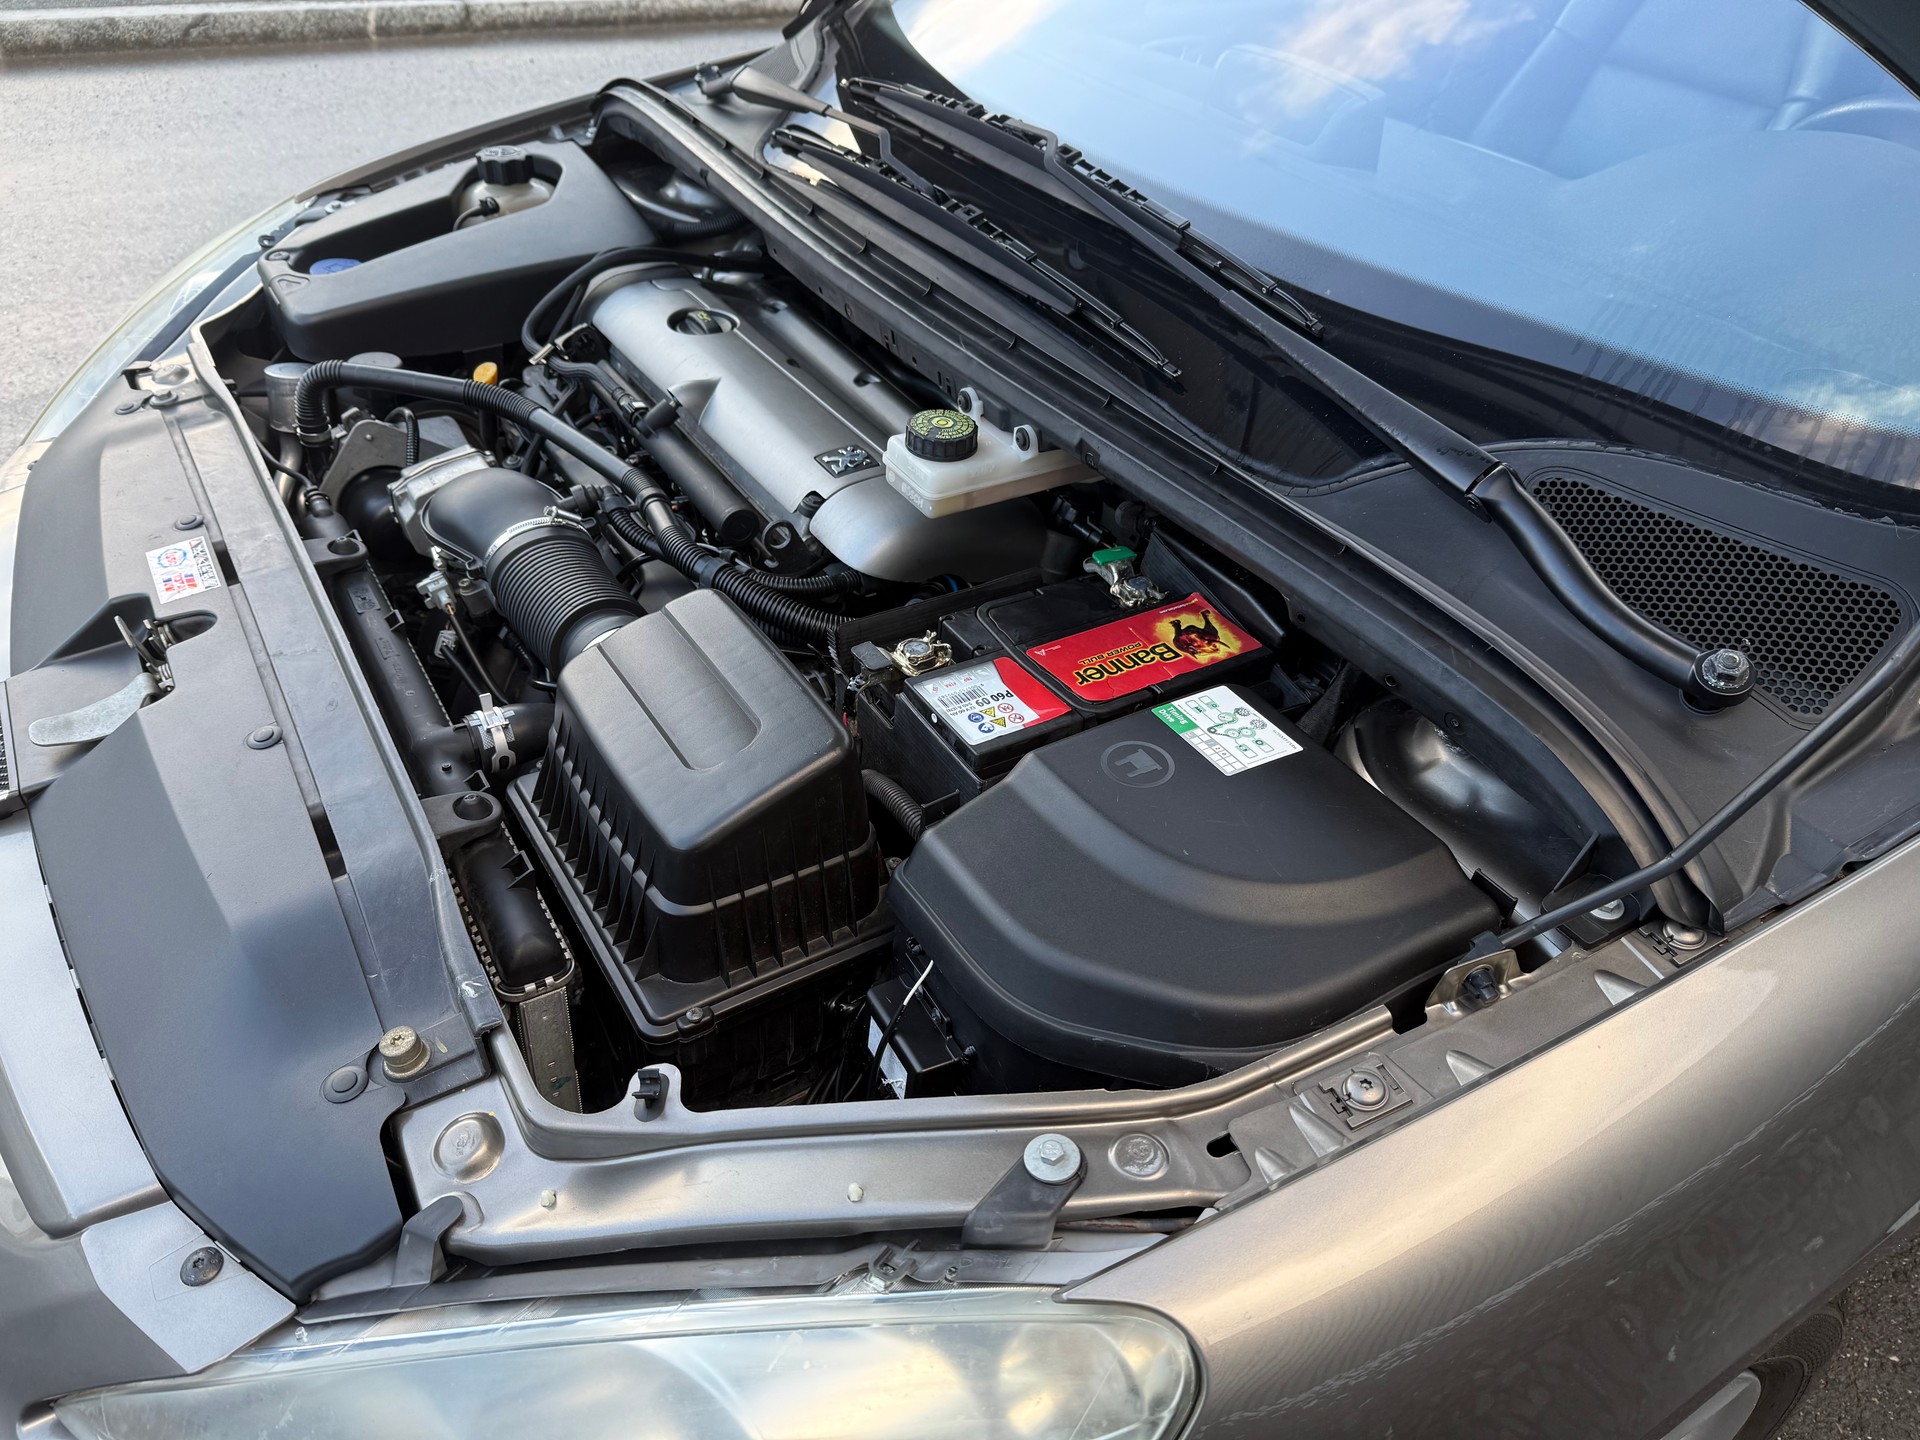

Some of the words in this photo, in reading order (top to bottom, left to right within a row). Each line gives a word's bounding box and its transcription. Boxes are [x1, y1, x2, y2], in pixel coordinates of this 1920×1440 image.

[901, 482, 924, 508] BOSCH
[1106, 641, 1143, 657] POWER
[1073, 641, 1184, 686] Banner
[1080, 653, 1105, 665] BULL
[975, 697, 991, 707] 09
[990, 689, 1014, 702] P60
[1158, 709, 1175, 723] Drive
[1166, 706, 1189, 725] Timing
